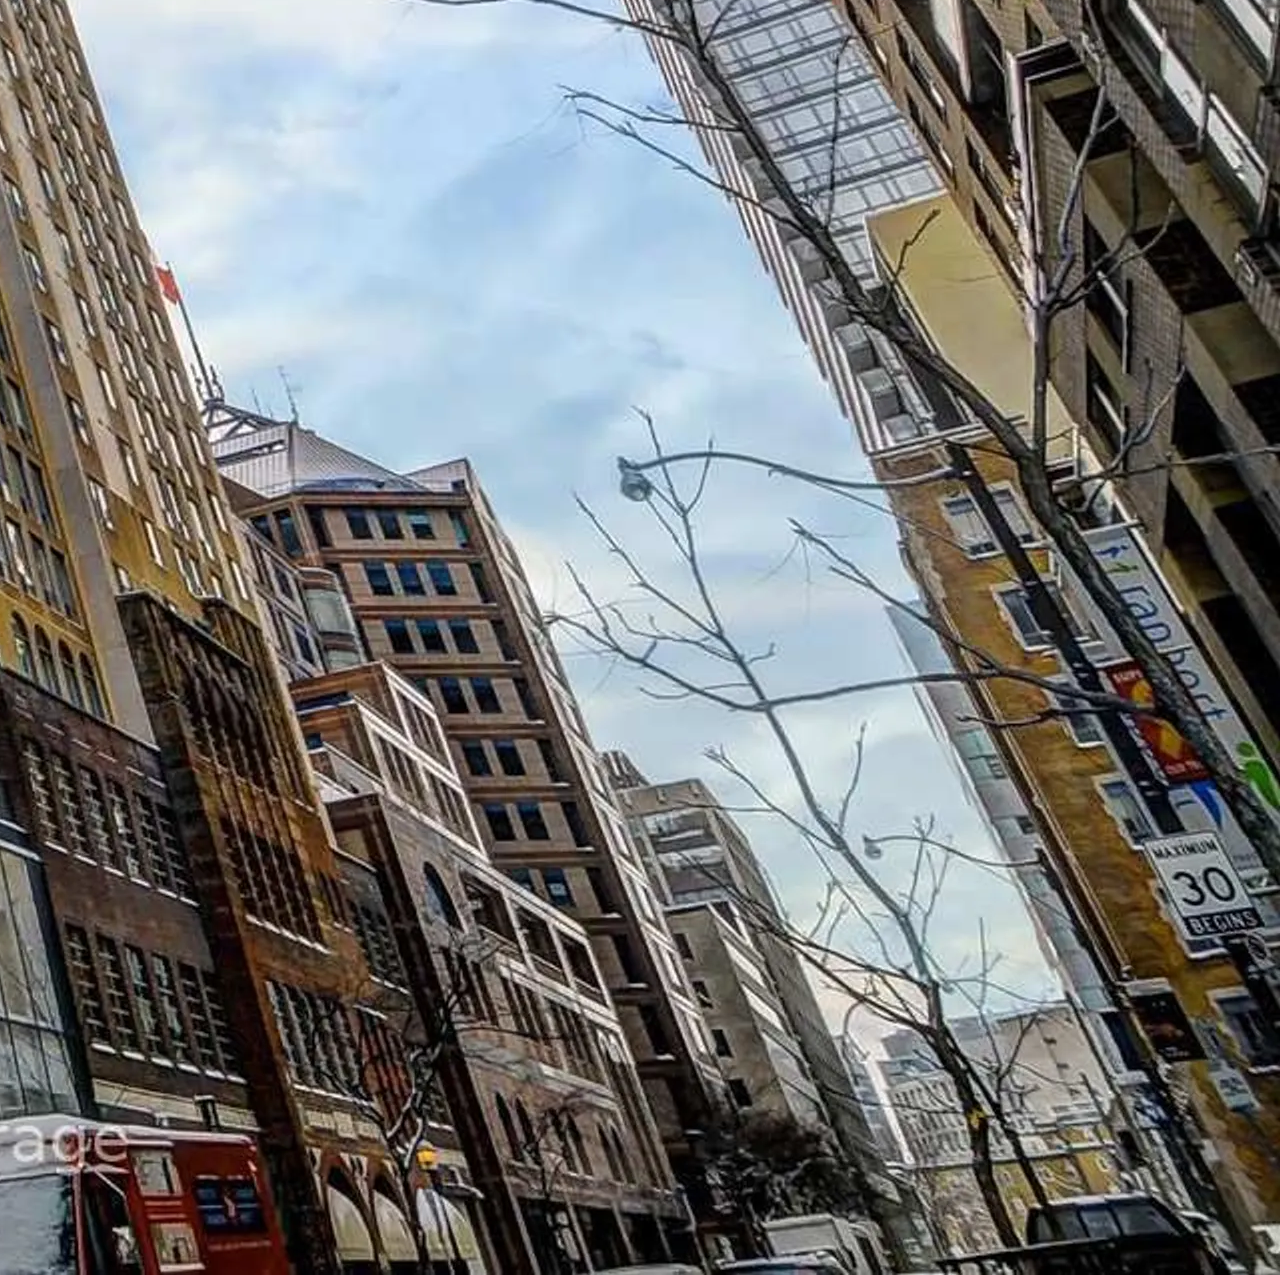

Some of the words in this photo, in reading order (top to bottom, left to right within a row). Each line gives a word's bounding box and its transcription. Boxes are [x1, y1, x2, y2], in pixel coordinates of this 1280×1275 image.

[1153, 838, 1219, 859] MAXIMUM
[1172, 866, 1236, 906] 30
[1188, 910, 1259, 935] BEGINS
